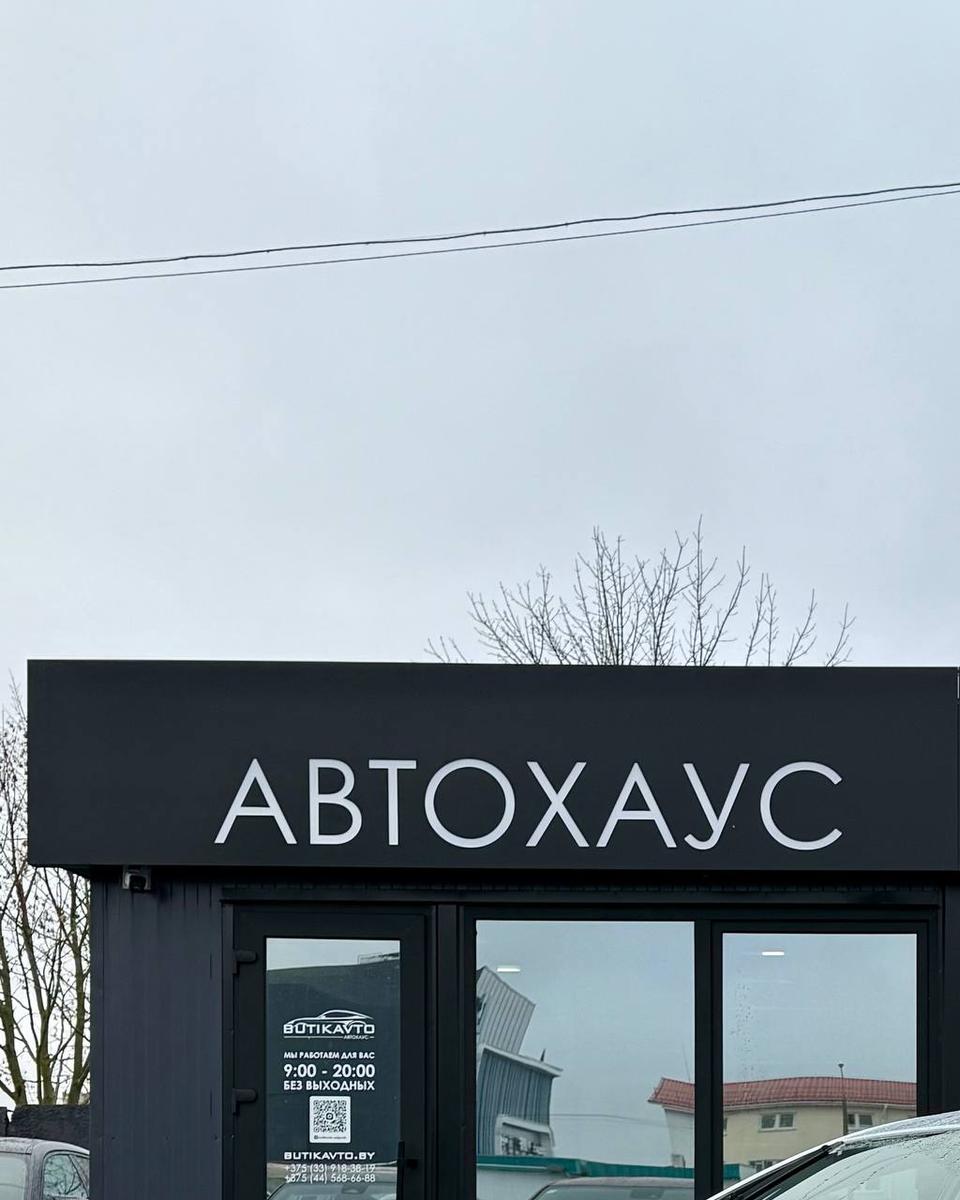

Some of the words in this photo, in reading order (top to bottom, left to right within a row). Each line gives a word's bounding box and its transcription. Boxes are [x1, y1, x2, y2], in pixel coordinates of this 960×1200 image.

[214, 758, 844, 850] АВТОХАУС
[283, 1024, 375, 1034] BUTIKAVTO
[283, 1051, 298, 1059] МЫ
[299, 1051, 339, 1059] РАБОТАЕМ
[341, 1051, 357, 1059] ДЛЯ
[358, 1051, 375, 1059] ВАС
[283, 1064, 317, 1078] 9:00
[332, 1064, 376, 1078] 20:00
[283, 1080, 303, 1091] БЕЗ
[306, 1080, 375, 1092] ВЫХОДНЫХ
[284, 1151, 376, 1160] BUTIKAVTO.BY
[310, 1174, 328, 1184] (44)
[330, 1174, 376, 1183] 568-66-88
